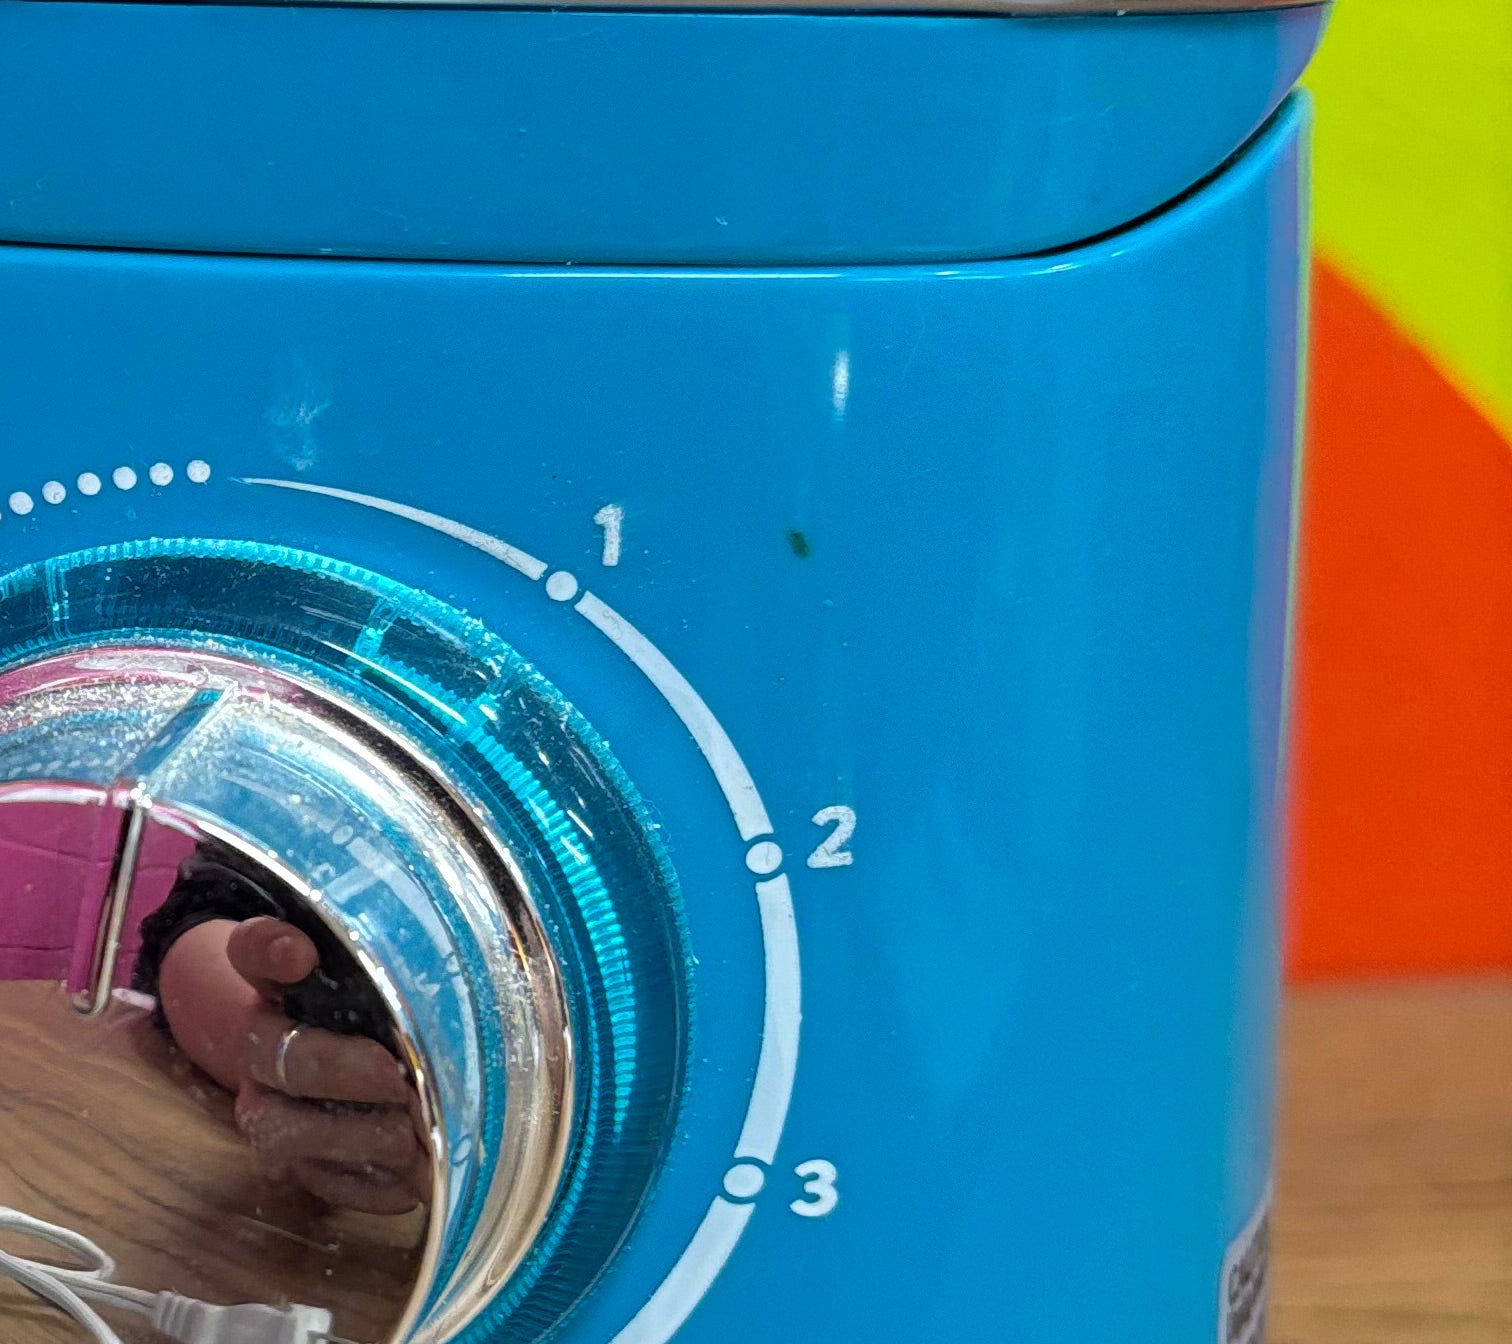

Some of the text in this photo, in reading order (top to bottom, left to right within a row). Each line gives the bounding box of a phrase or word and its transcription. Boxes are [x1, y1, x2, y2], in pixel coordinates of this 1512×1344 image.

[593, 503, 624, 567] 1
[806, 805, 858, 870] 2
[789, 1158, 839, 1218] 3
